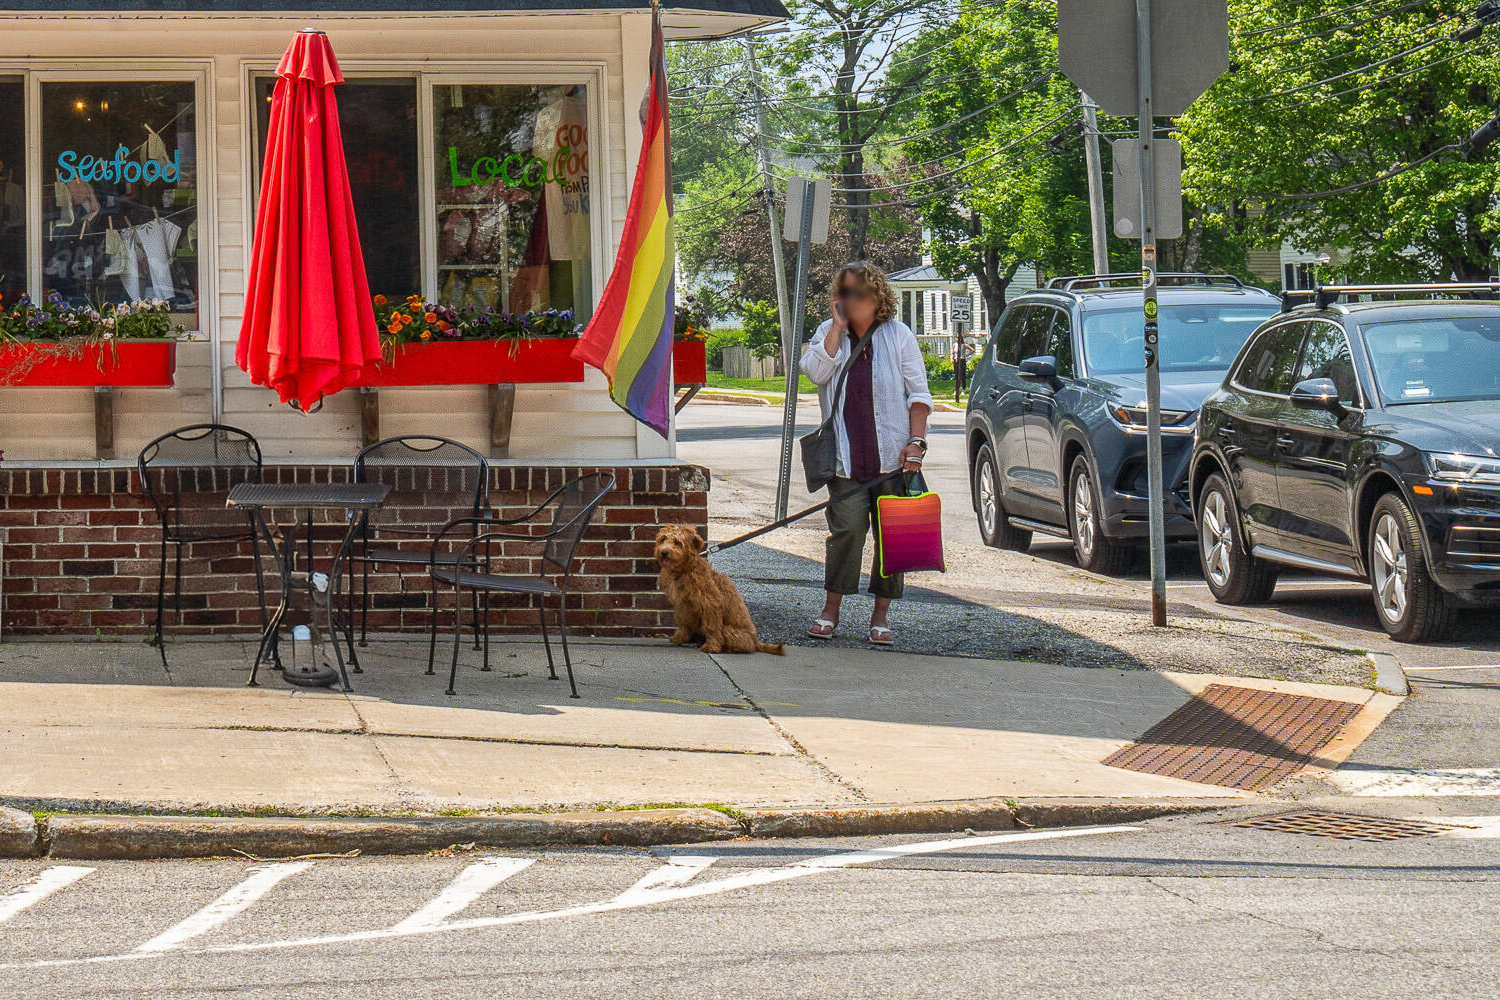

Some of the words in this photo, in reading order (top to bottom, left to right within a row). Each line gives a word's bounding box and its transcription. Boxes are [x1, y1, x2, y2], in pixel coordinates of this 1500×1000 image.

[57, 146, 180, 184] Seafood
[449, 146, 570, 188] Local
[952, 310, 970, 320] 25
